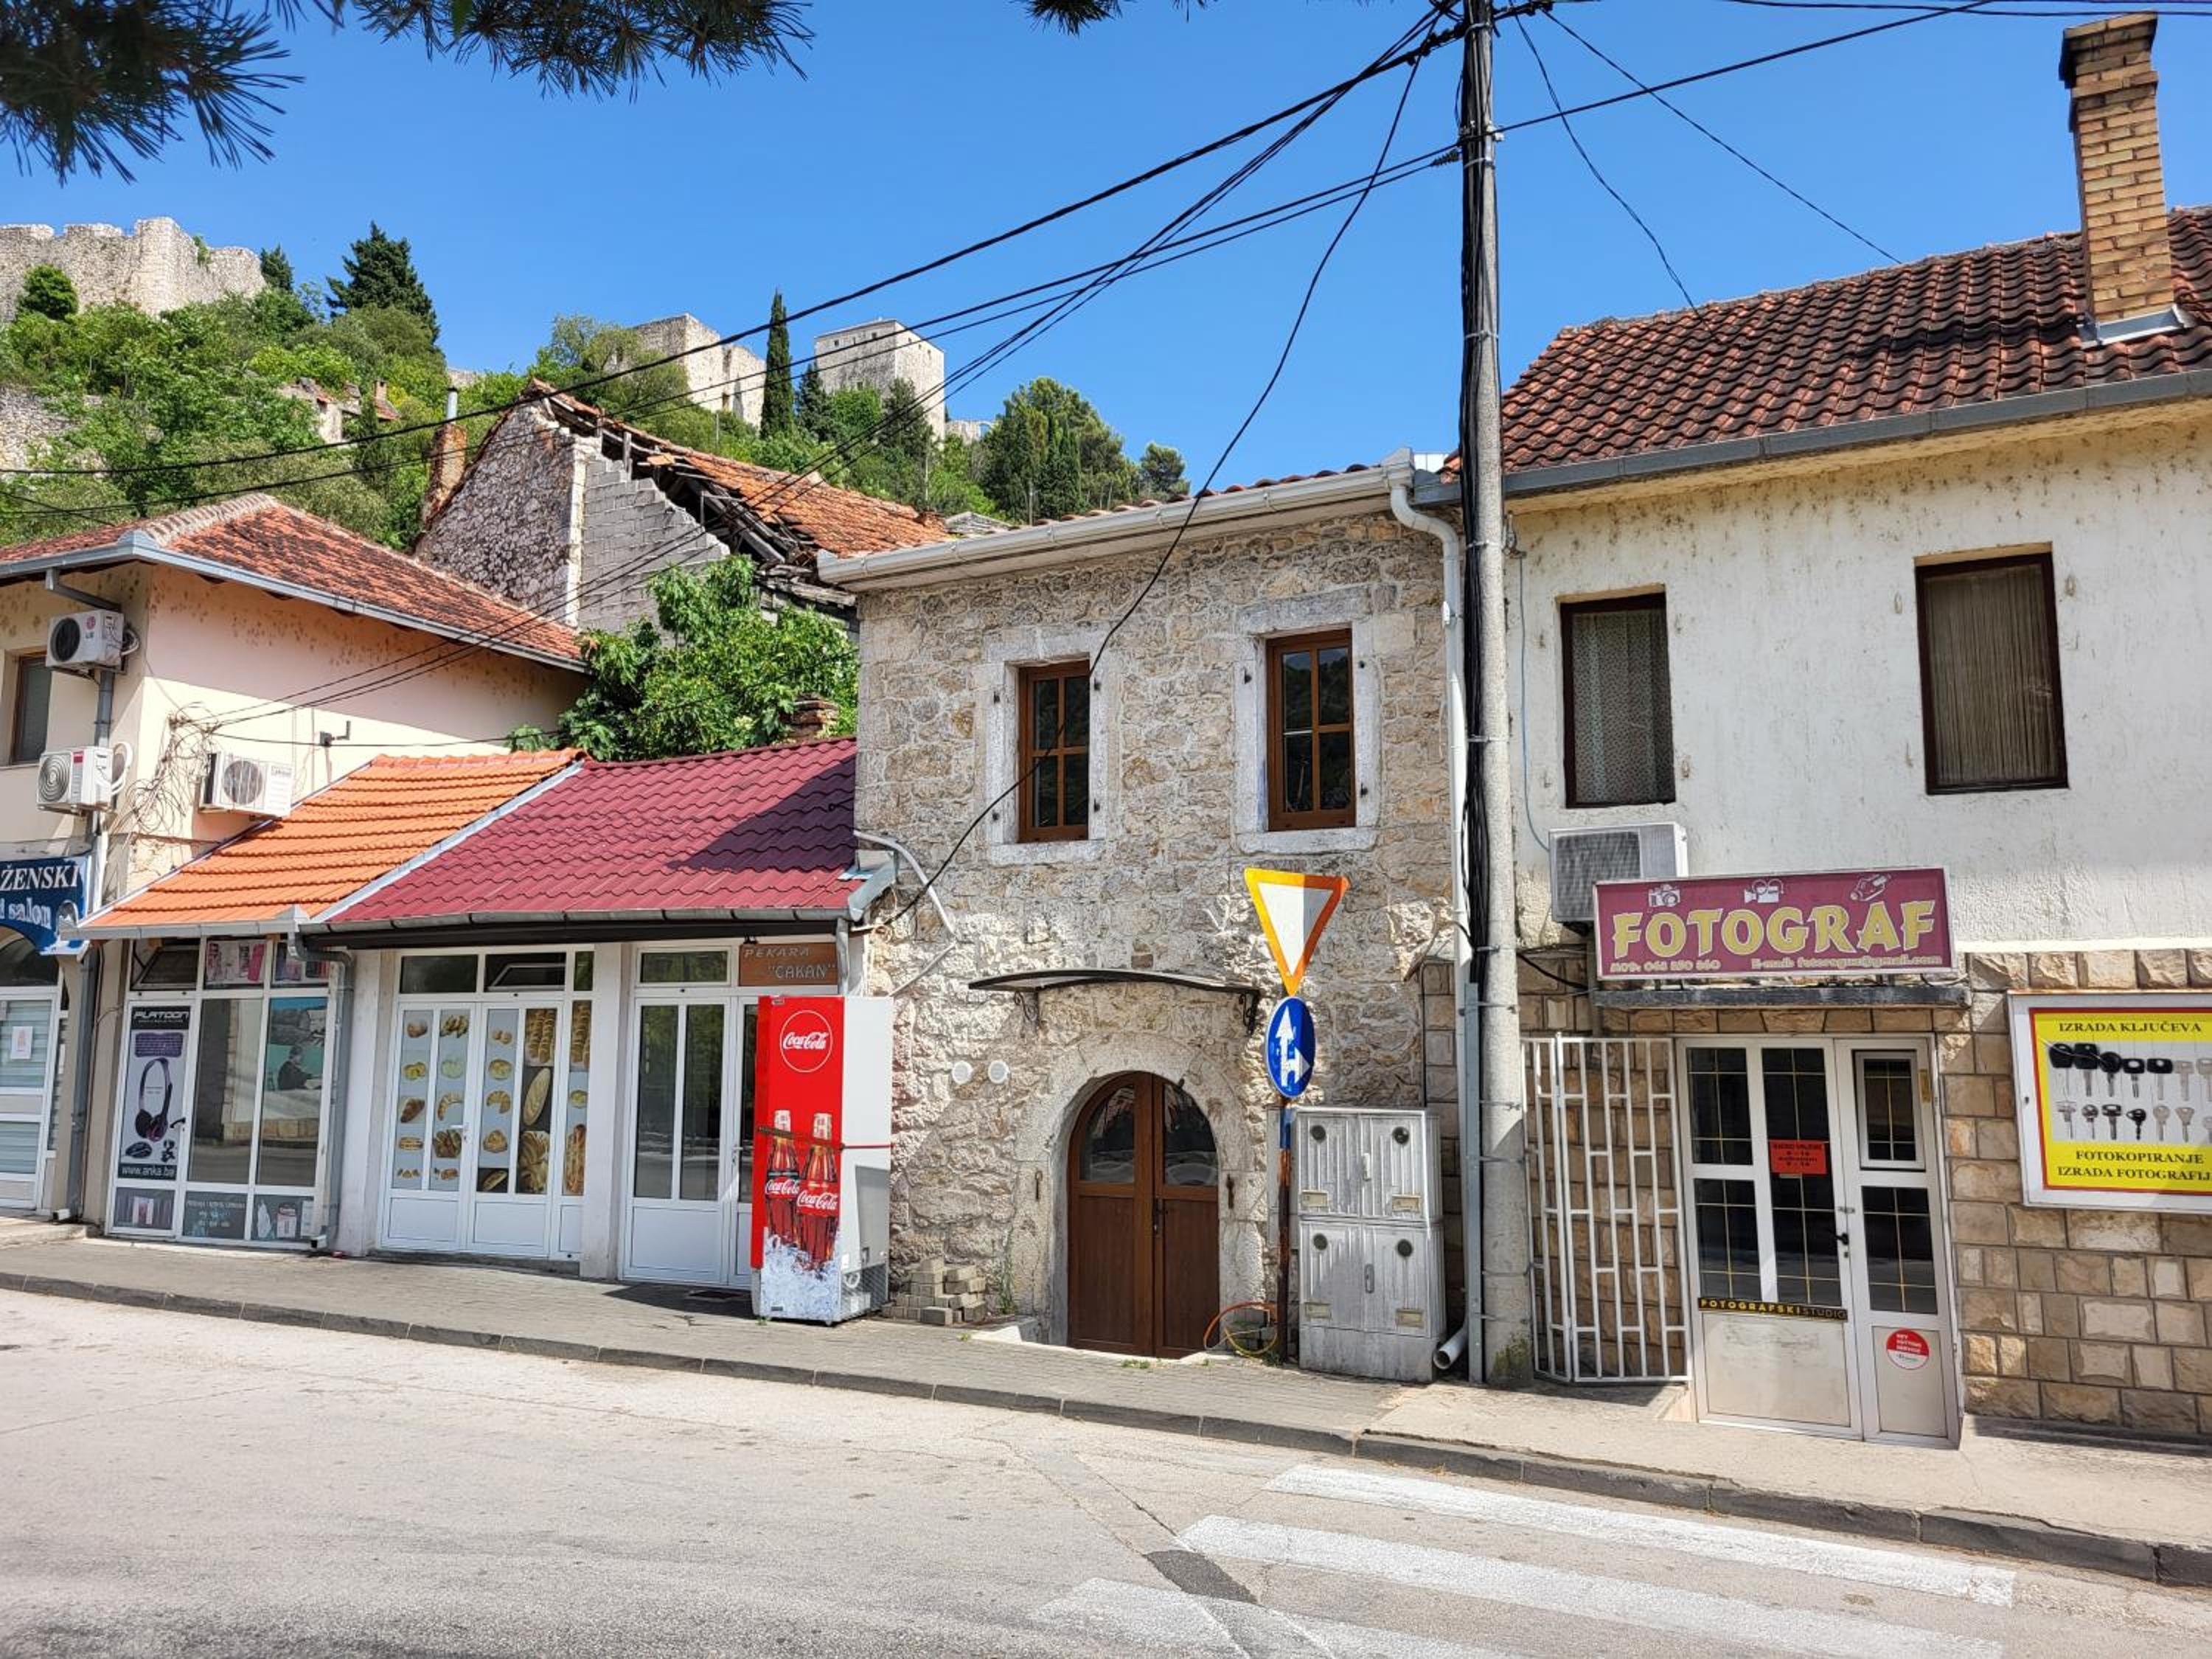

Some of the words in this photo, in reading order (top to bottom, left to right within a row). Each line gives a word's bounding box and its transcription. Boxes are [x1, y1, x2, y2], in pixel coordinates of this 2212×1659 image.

[0, 863, 80, 891] ŽENSKI
[8, 897, 52, 930] salon
[1612, 900, 1935, 959] FOTOGRAF
[744, 947, 809, 958] PEKARA
[2059, 1022, 2115, 1032] IZRADA
[2121, 1020, 2202, 1032] KLJUČEVA
[2076, 1150, 2204, 1164] FOTOKOPIRANJE
[2057, 1166, 2112, 1178] IZRADA
